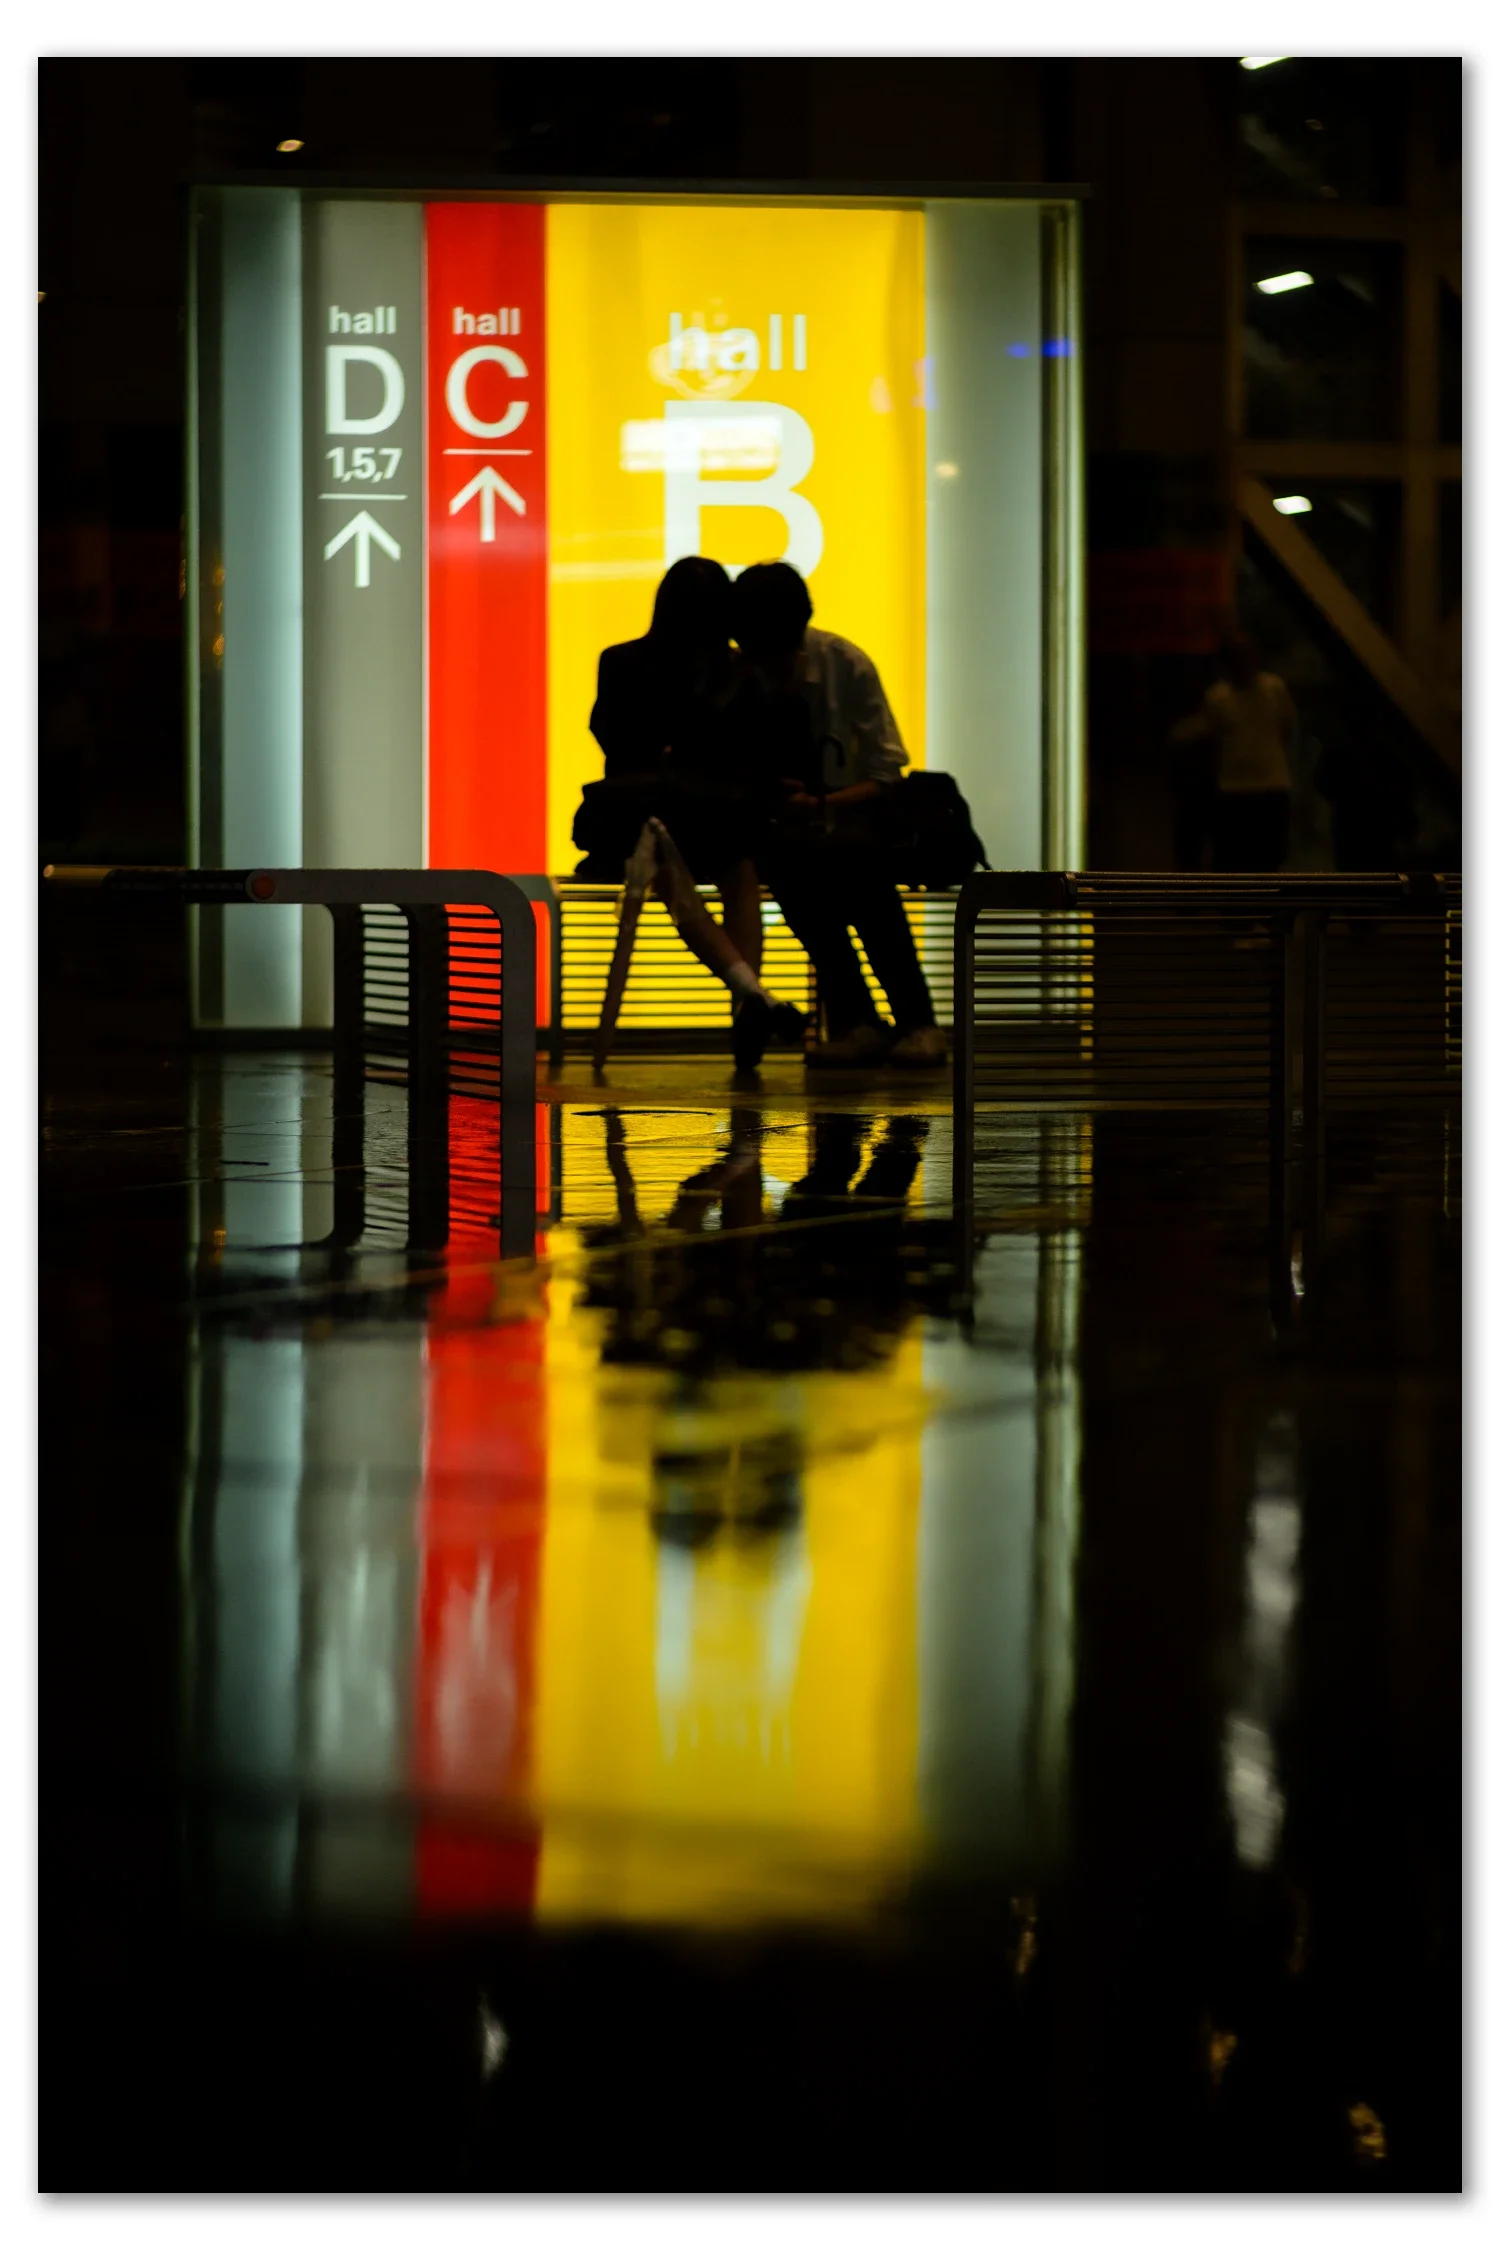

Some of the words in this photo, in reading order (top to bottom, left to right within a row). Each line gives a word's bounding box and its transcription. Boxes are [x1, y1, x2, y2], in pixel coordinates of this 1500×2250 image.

[329, 305, 397, 335] hall
[452, 306, 521, 336] hall
[669, 312, 807, 371] hall
[325, 345, 406, 436] D
[445, 345, 530, 439] C
[325, 446, 403, 483] 1,5,7
[664, 400, 825, 580] B
